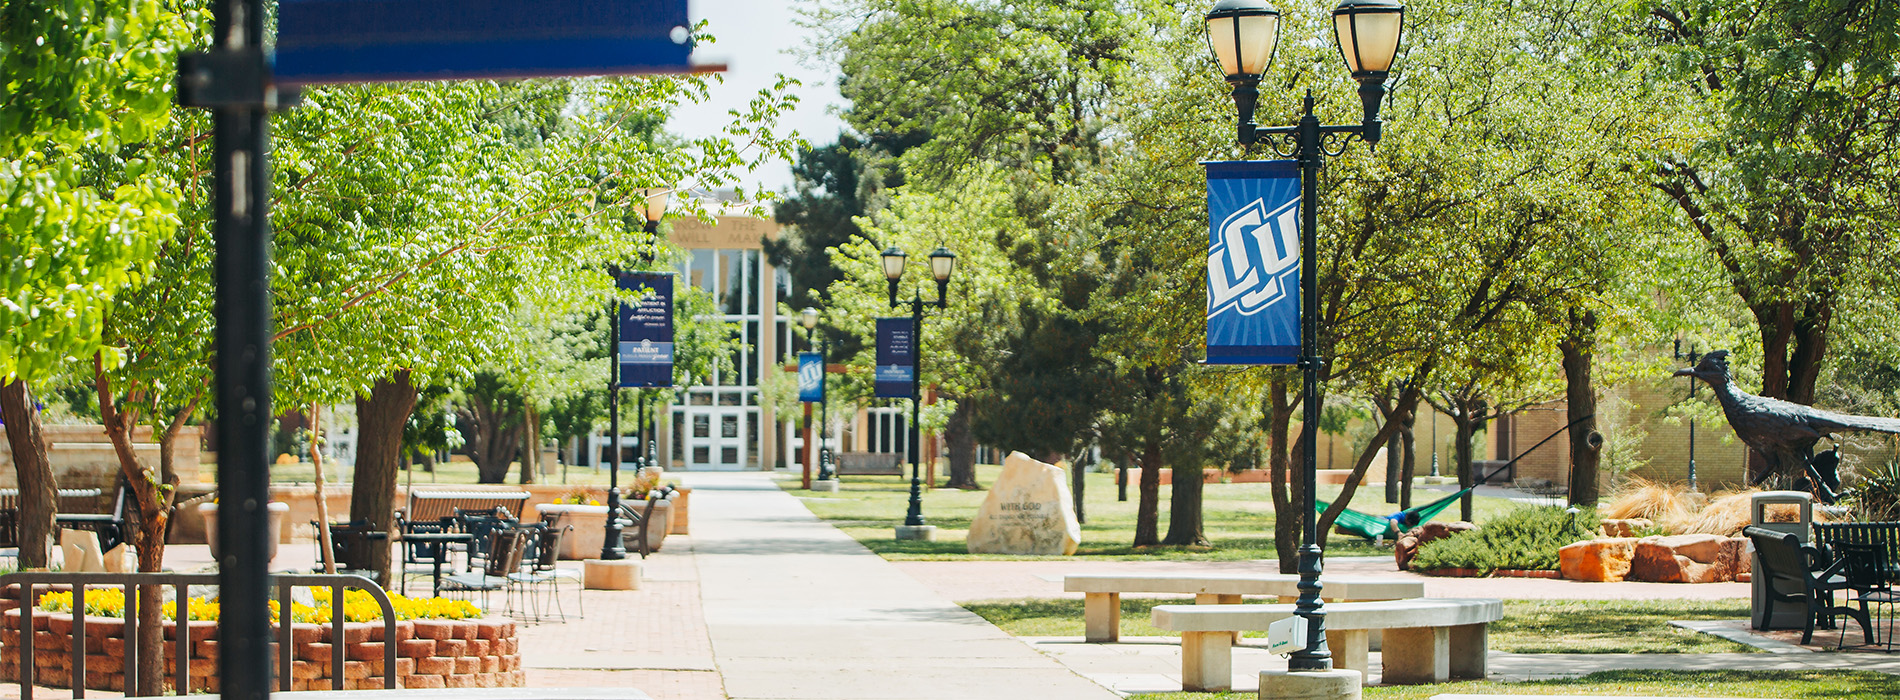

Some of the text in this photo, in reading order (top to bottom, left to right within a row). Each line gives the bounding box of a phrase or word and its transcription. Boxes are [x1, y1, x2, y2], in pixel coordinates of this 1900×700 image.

[732, 220, 756, 231] THE
[677, 232, 761, 243] WILL MAK
[1207, 197, 1301, 319] LCU
[1001, 502, 1042, 511] WITH GOD
